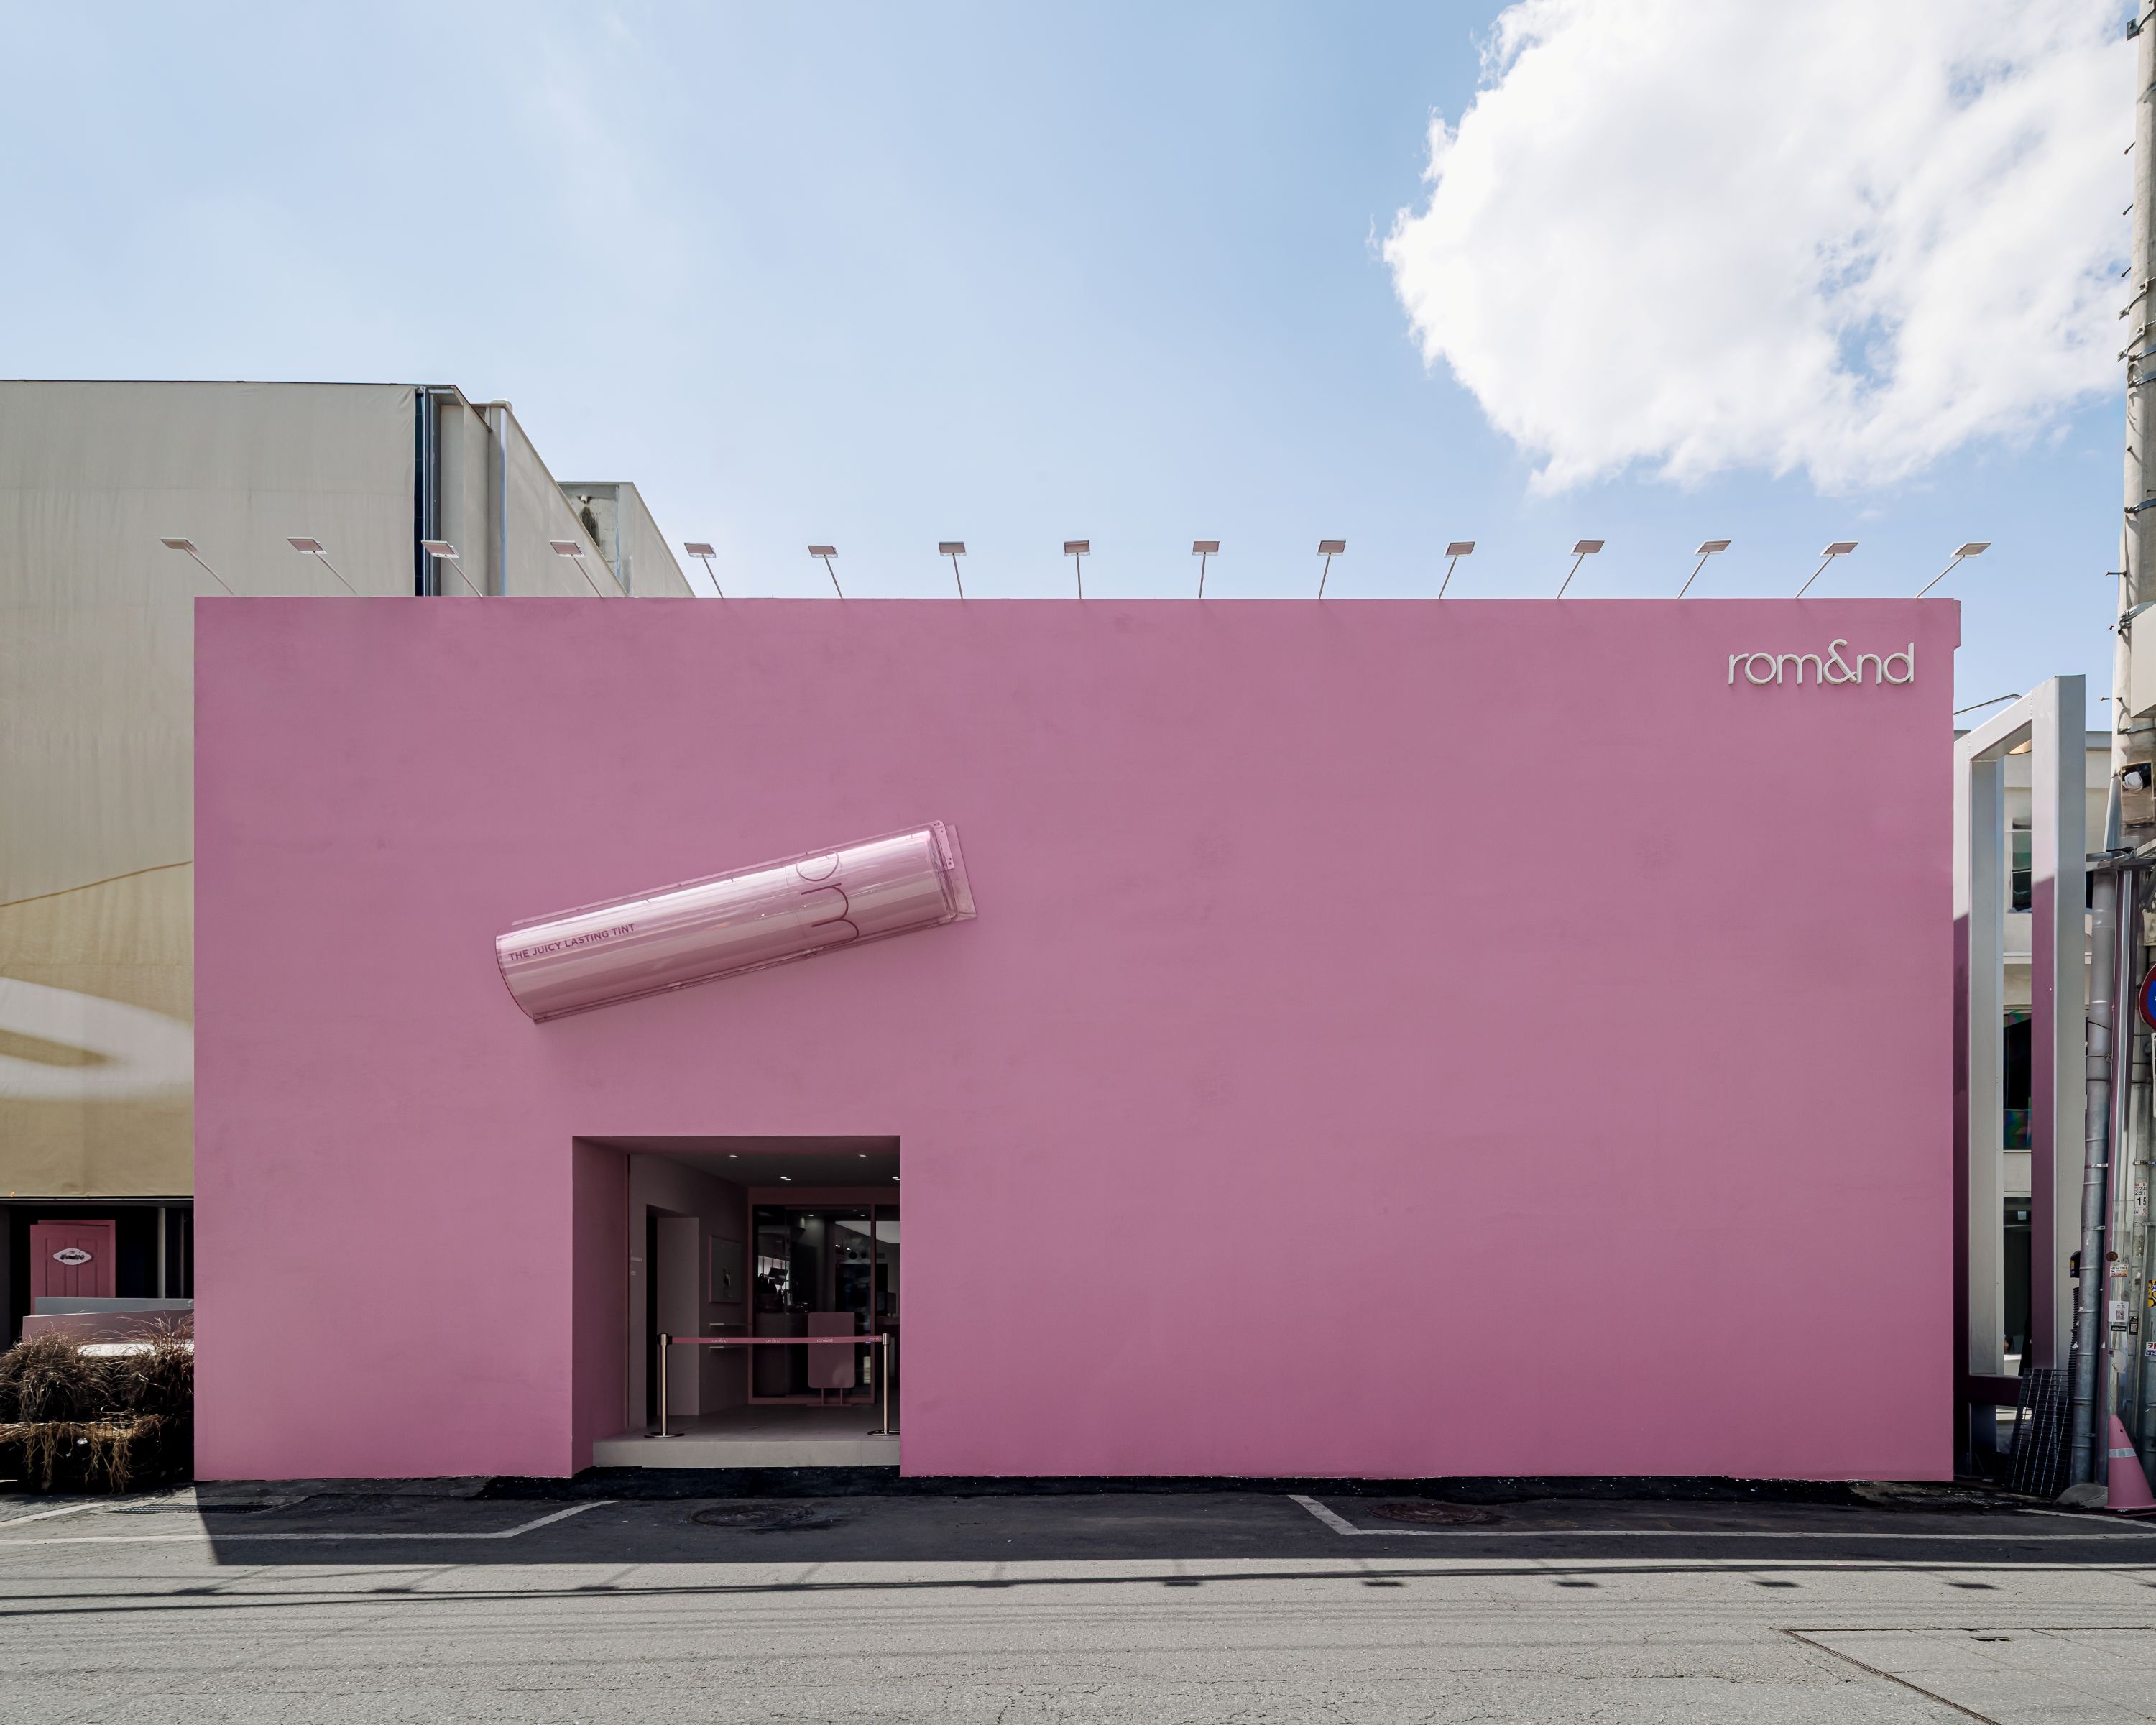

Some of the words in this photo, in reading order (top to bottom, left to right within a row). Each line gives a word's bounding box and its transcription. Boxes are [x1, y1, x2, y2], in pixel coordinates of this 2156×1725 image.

[1728, 638, 1915, 685] rom&nd
[509, 949, 530, 961] THE
[533, 942, 561, 955] JUICY
[564, 930, 609, 947] LASTING
[612, 924, 635, 936] TINT
[2137, 1197, 2147, 1206] 15
